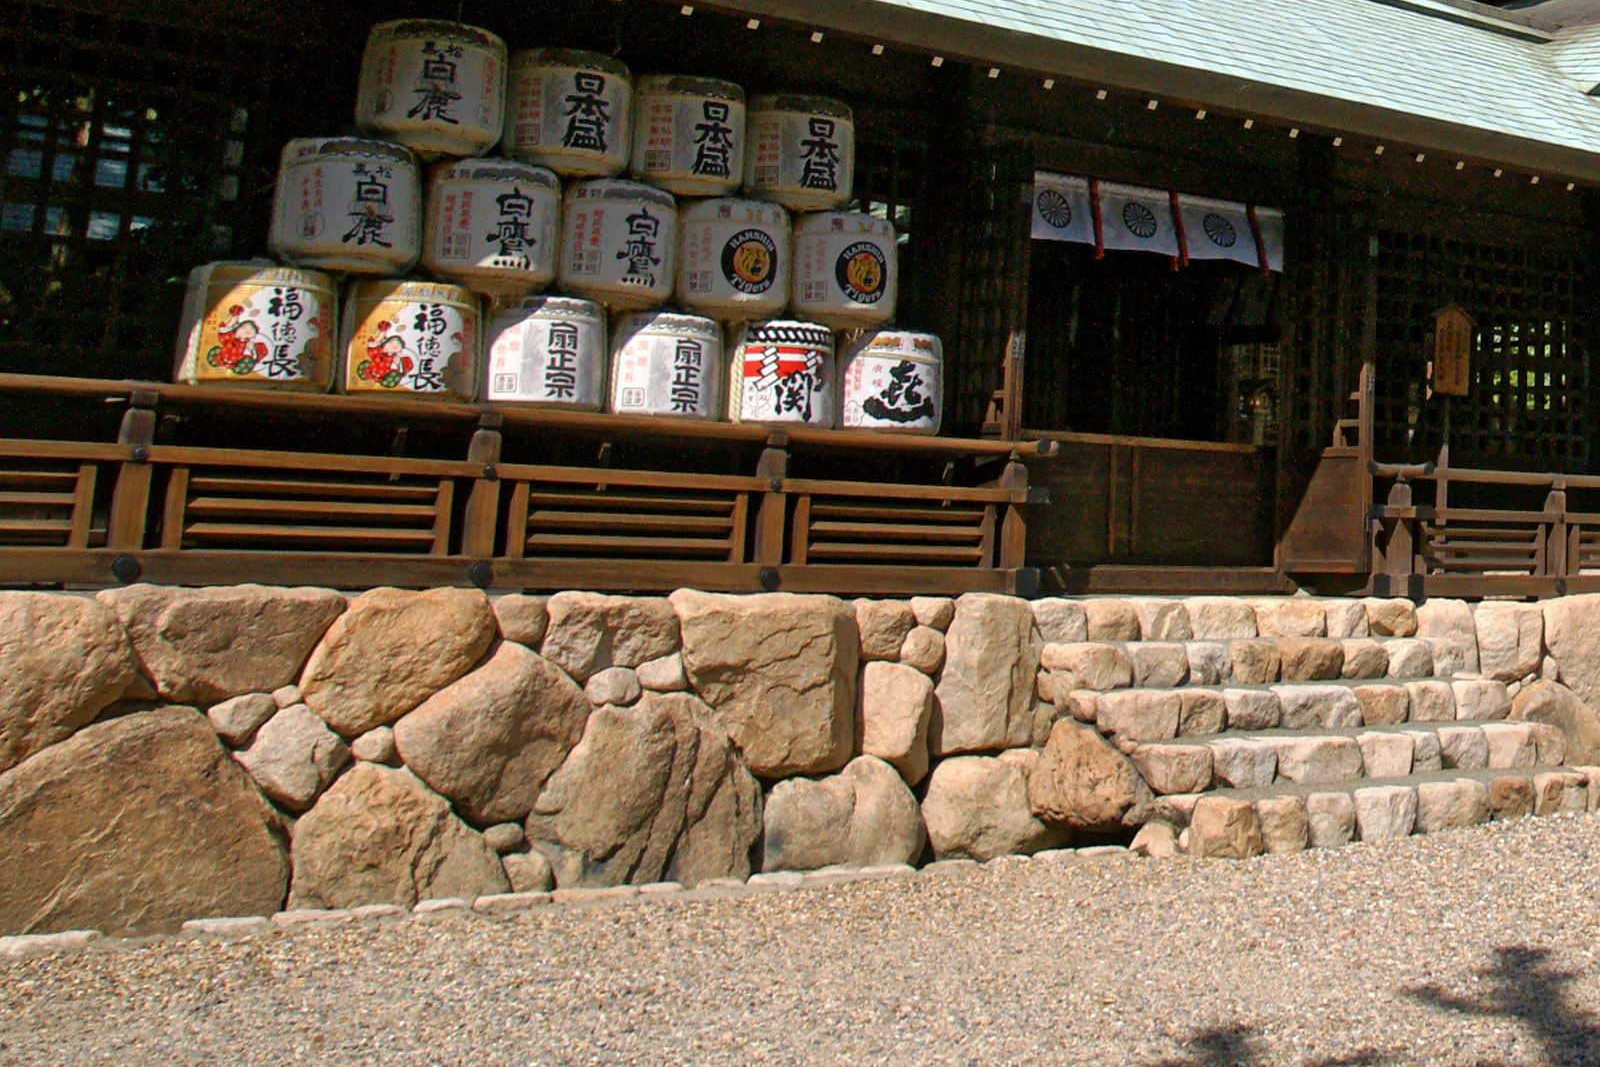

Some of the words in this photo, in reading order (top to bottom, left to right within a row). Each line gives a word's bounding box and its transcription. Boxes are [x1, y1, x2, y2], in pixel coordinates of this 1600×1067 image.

[406, 53, 463, 125] 白鹿
[562, 72, 610, 154] 日本盛
[691, 100, 734, 180] 日本盛
[799, 117, 839, 194] 日本盛
[342, 174, 395, 249] 白鹿
[486, 186, 537, 271] 白鷹
[616, 206, 662, 288] 白鷹
[729, 231, 775, 252] HANSHIN
[730, 273, 771, 293] Tigers
[842, 242, 885, 264] HANSHIN
[843, 284, 882, 303] Tigers
[263, 287, 303, 377] 福徳長
[408, 303, 448, 390] 福徳長
[545, 321, 579, 399] 扇正宗
[670, 338, 702, 412] 扇正宗
[774, 370, 813, 422] 関
